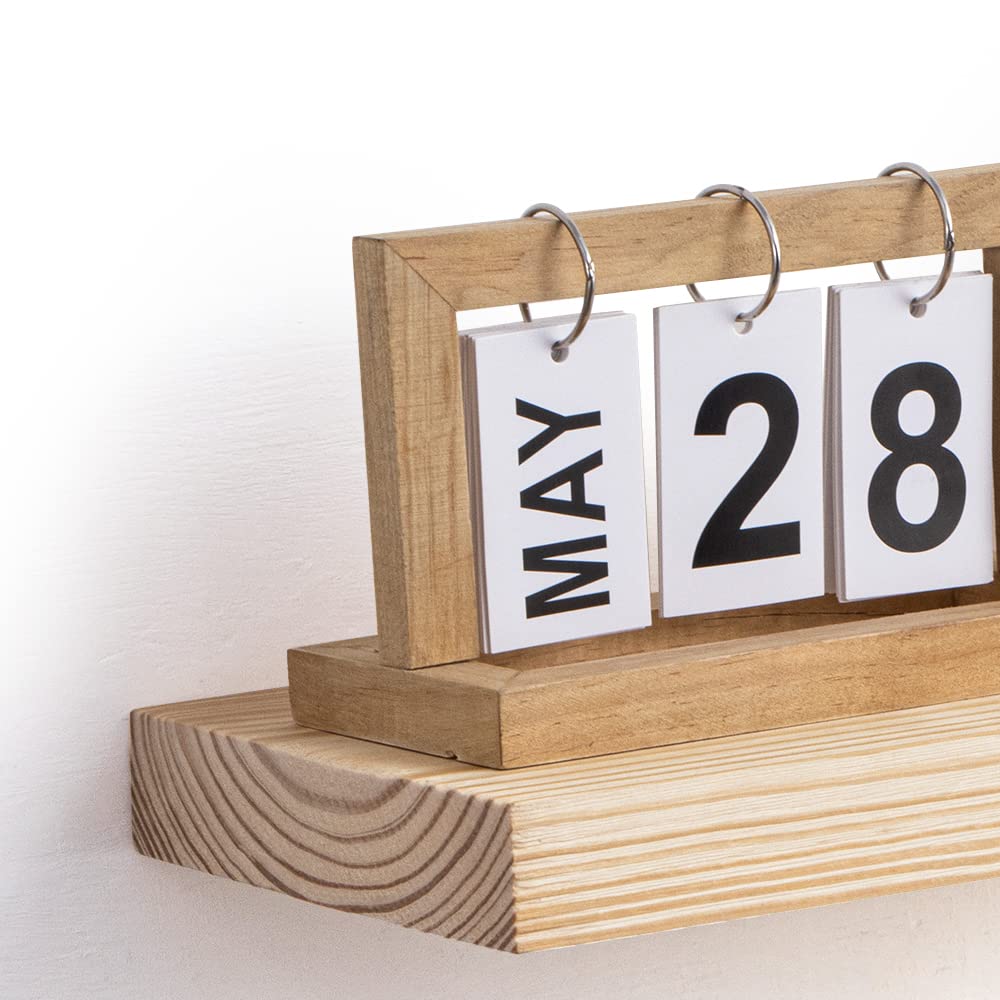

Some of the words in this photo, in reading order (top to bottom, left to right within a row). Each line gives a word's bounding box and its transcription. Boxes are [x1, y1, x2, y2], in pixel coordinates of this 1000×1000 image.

[515, 398, 610, 619] MAY
[692, 372, 800, 569] 2
[867, 361, 966, 553] 8
